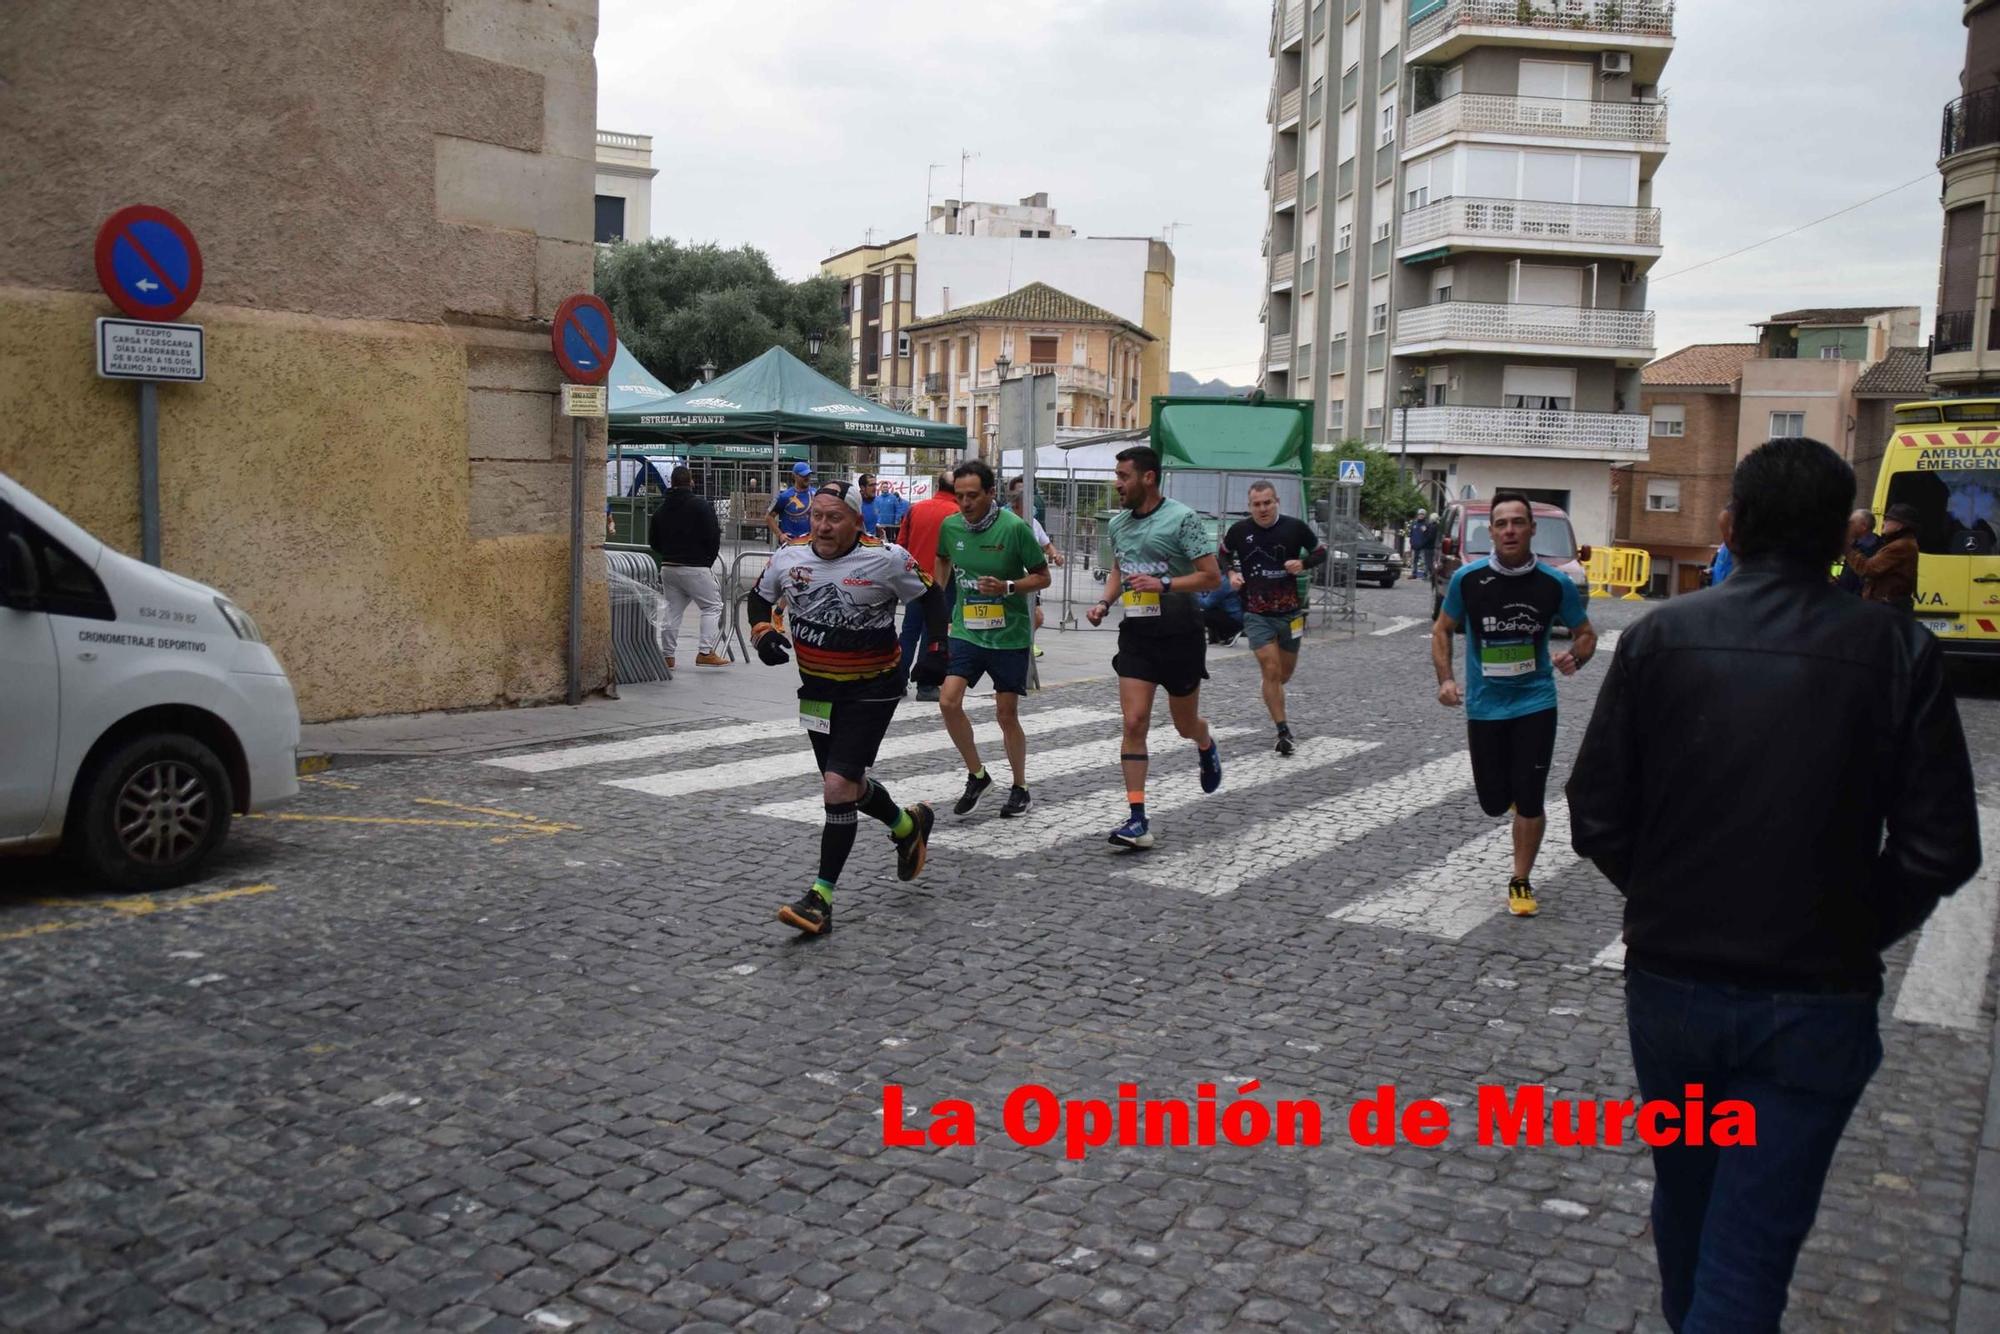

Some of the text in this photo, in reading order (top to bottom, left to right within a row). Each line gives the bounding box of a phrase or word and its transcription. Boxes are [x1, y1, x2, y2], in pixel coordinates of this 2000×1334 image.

[136, 328, 172, 338] EXCEPTO
[112, 336, 141, 345] CARGA
[150, 339, 193, 348] DESCARGA
[116, 344, 191, 357] DÍAS LABORABLES
[160, 366, 197, 375] MINUTOS
[640, 415, 681, 424] ESTRELLA
[687, 415, 725, 424] LEVANTE
[844, 421, 885, 433] ESTRELLA
[891, 426, 926, 438] LEVANTE
[1132, 592, 1142, 603] 99
[139, 607, 157, 618] 634
[159, 610, 170, 620] 29
[185, 613, 197, 624] 82
[974, 606, 988, 616] 157
[78, 631, 206, 652] CRONOMETRAJE DEPORTIVO
